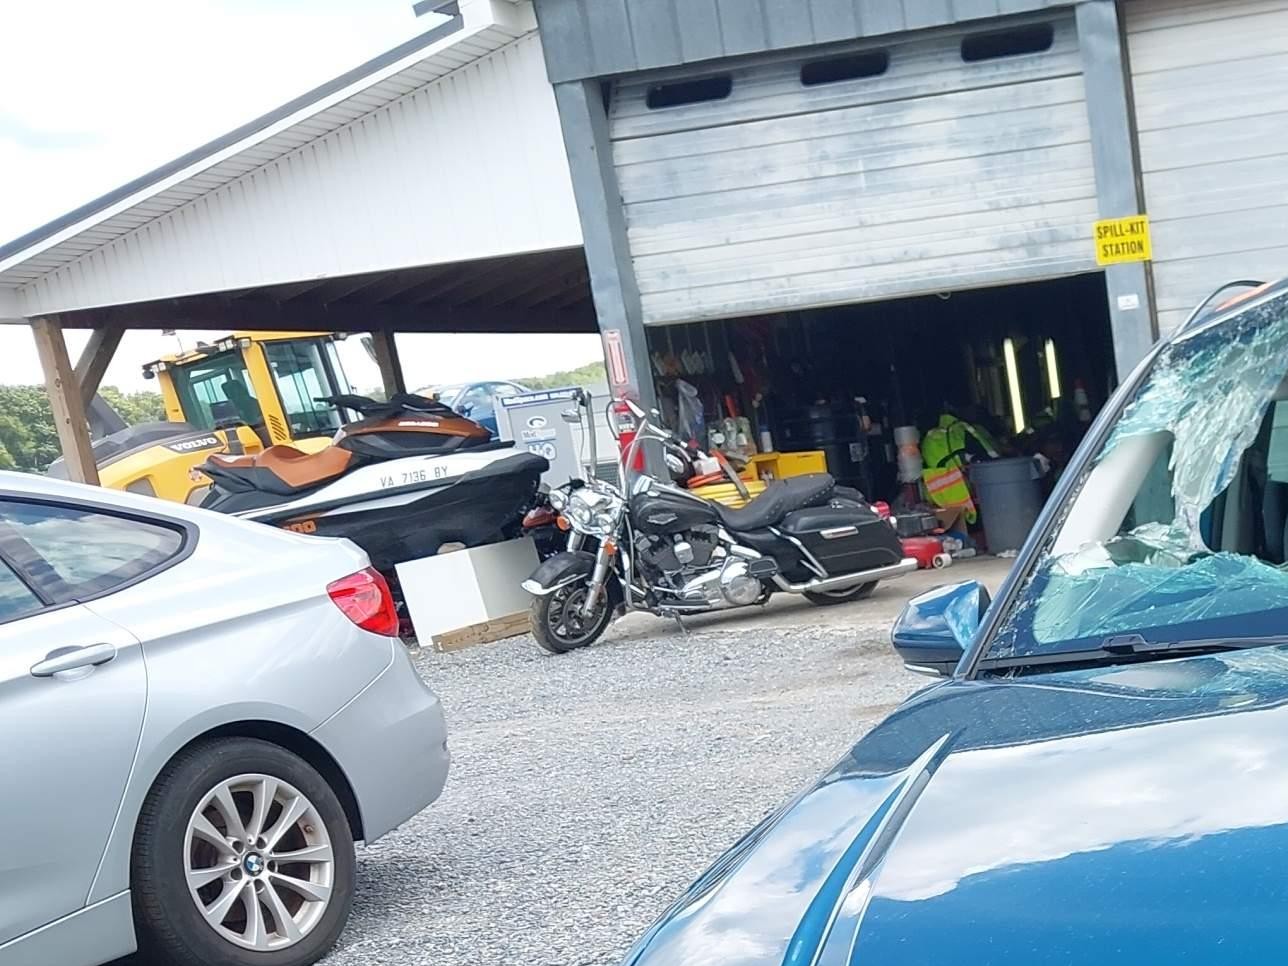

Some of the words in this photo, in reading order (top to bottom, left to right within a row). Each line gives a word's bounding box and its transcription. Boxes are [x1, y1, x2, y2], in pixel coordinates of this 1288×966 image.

[1097, 220, 1145, 239] SPILL-KIT
[1102, 240, 1145, 258] STATION
[170, 437, 217, 451] VOLVO
[380, 476, 395, 487] VA
[402, 468, 426, 483] 7136
